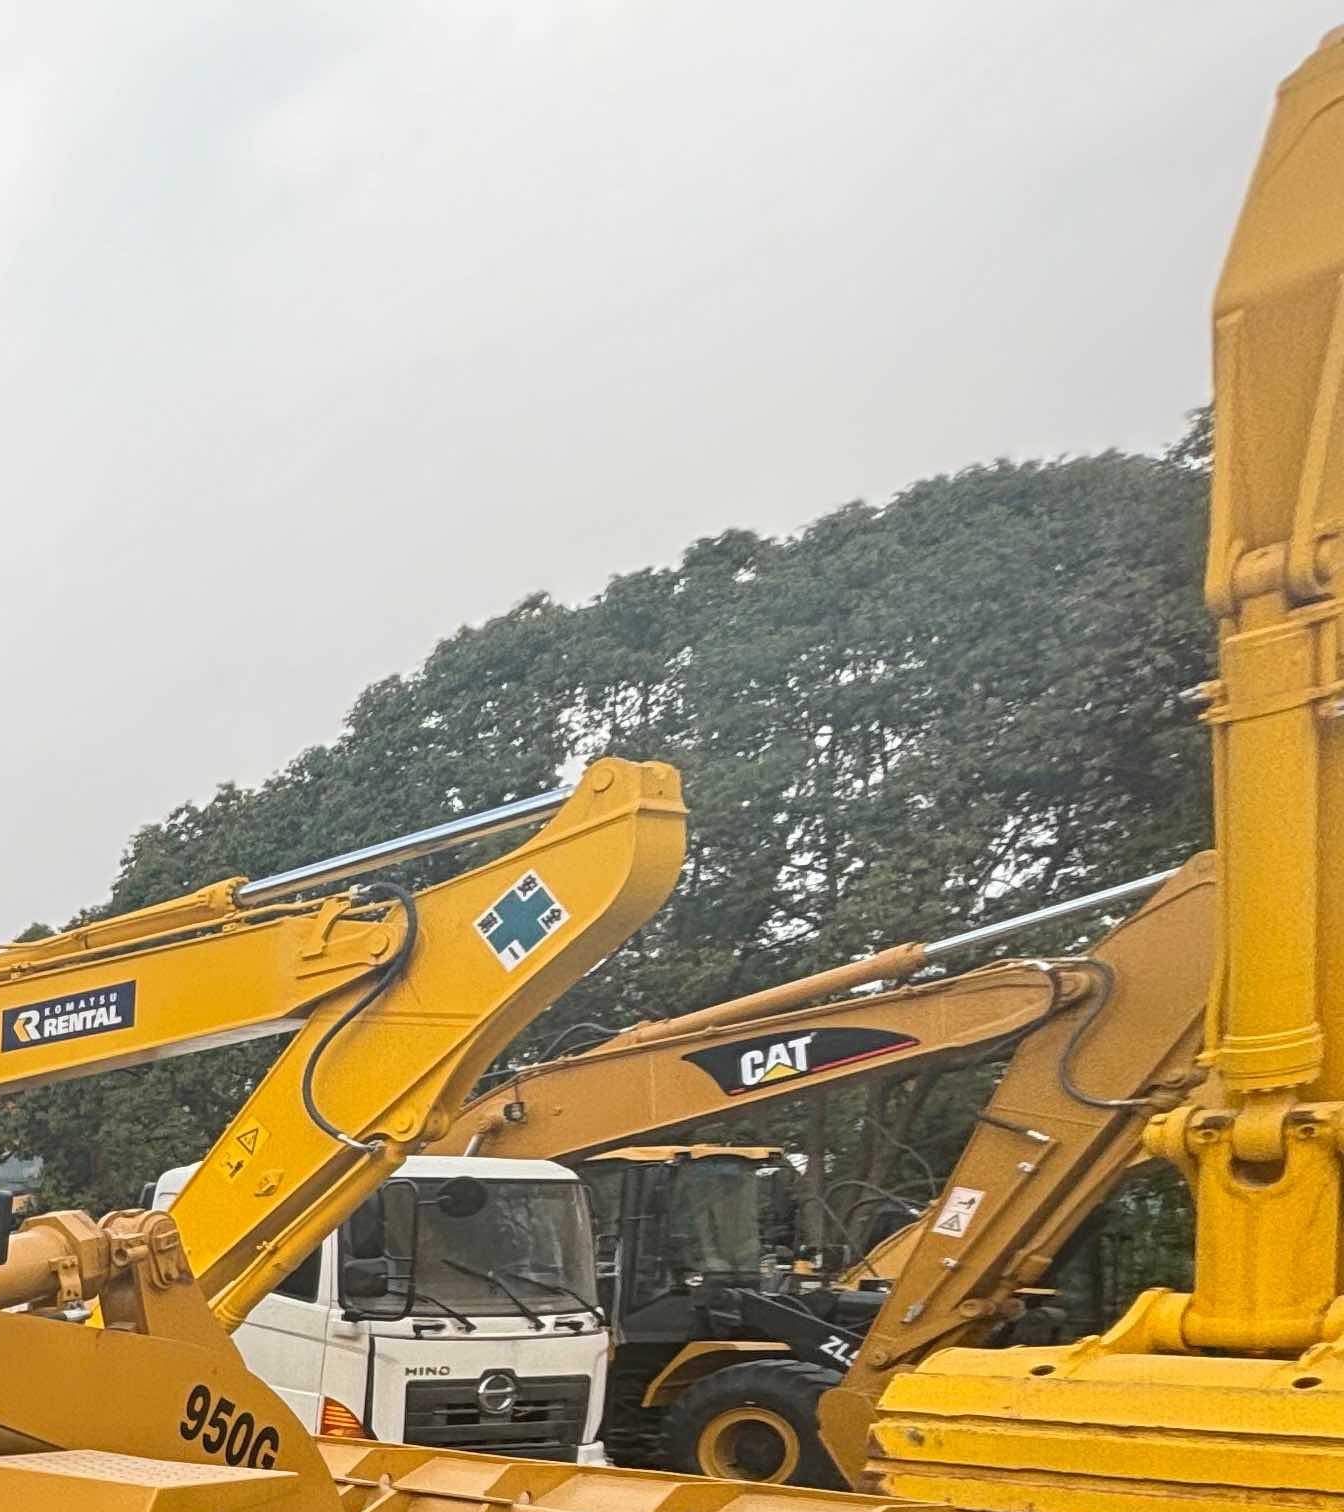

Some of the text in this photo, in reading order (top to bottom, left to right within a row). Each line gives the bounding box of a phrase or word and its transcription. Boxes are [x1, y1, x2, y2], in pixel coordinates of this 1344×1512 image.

[43, 1004, 123, 1038] RENTAL
[44, 992, 118, 1016] KOMATSU
[740, 1035, 812, 1086] CAT
[404, 1366, 450, 1376] HINO
[180, 1384, 280, 1470] 950G
